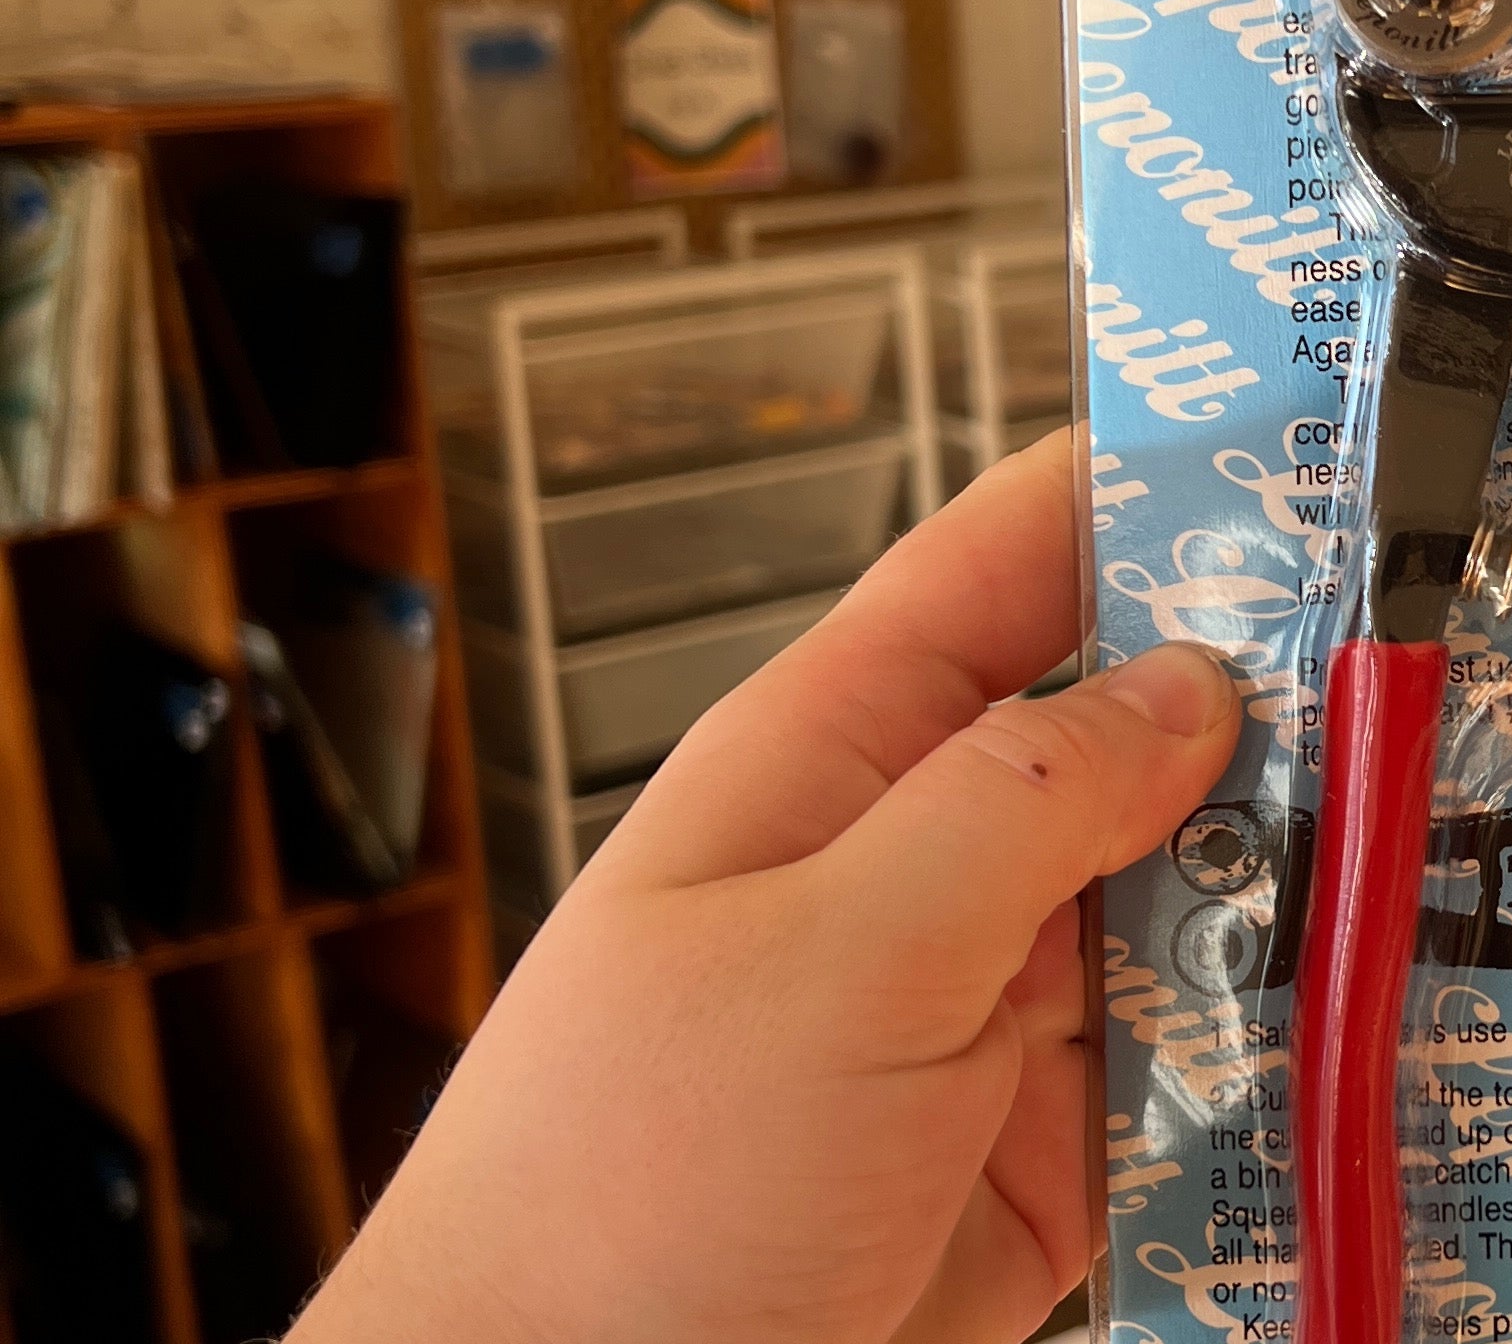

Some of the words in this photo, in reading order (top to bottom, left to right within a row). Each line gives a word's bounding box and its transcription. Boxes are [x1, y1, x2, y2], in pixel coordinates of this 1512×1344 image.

[1291, 258, 1362, 282] ness
[1291, 299, 1362, 323] ease
[1456, 1021, 1508, 1044] use
[1439, 1080, 1483, 1107] the
[1209, 1126, 1254, 1151] the
[1457, 1122, 1492, 1149] up
[1210, 1167, 1228, 1190] a
[1238, 1159, 1281, 1189] bin
[1434, 1158, 1511, 1186] catch
[1211, 1236, 1244, 1266] all
[1212, 1280, 1242, 1304] or
